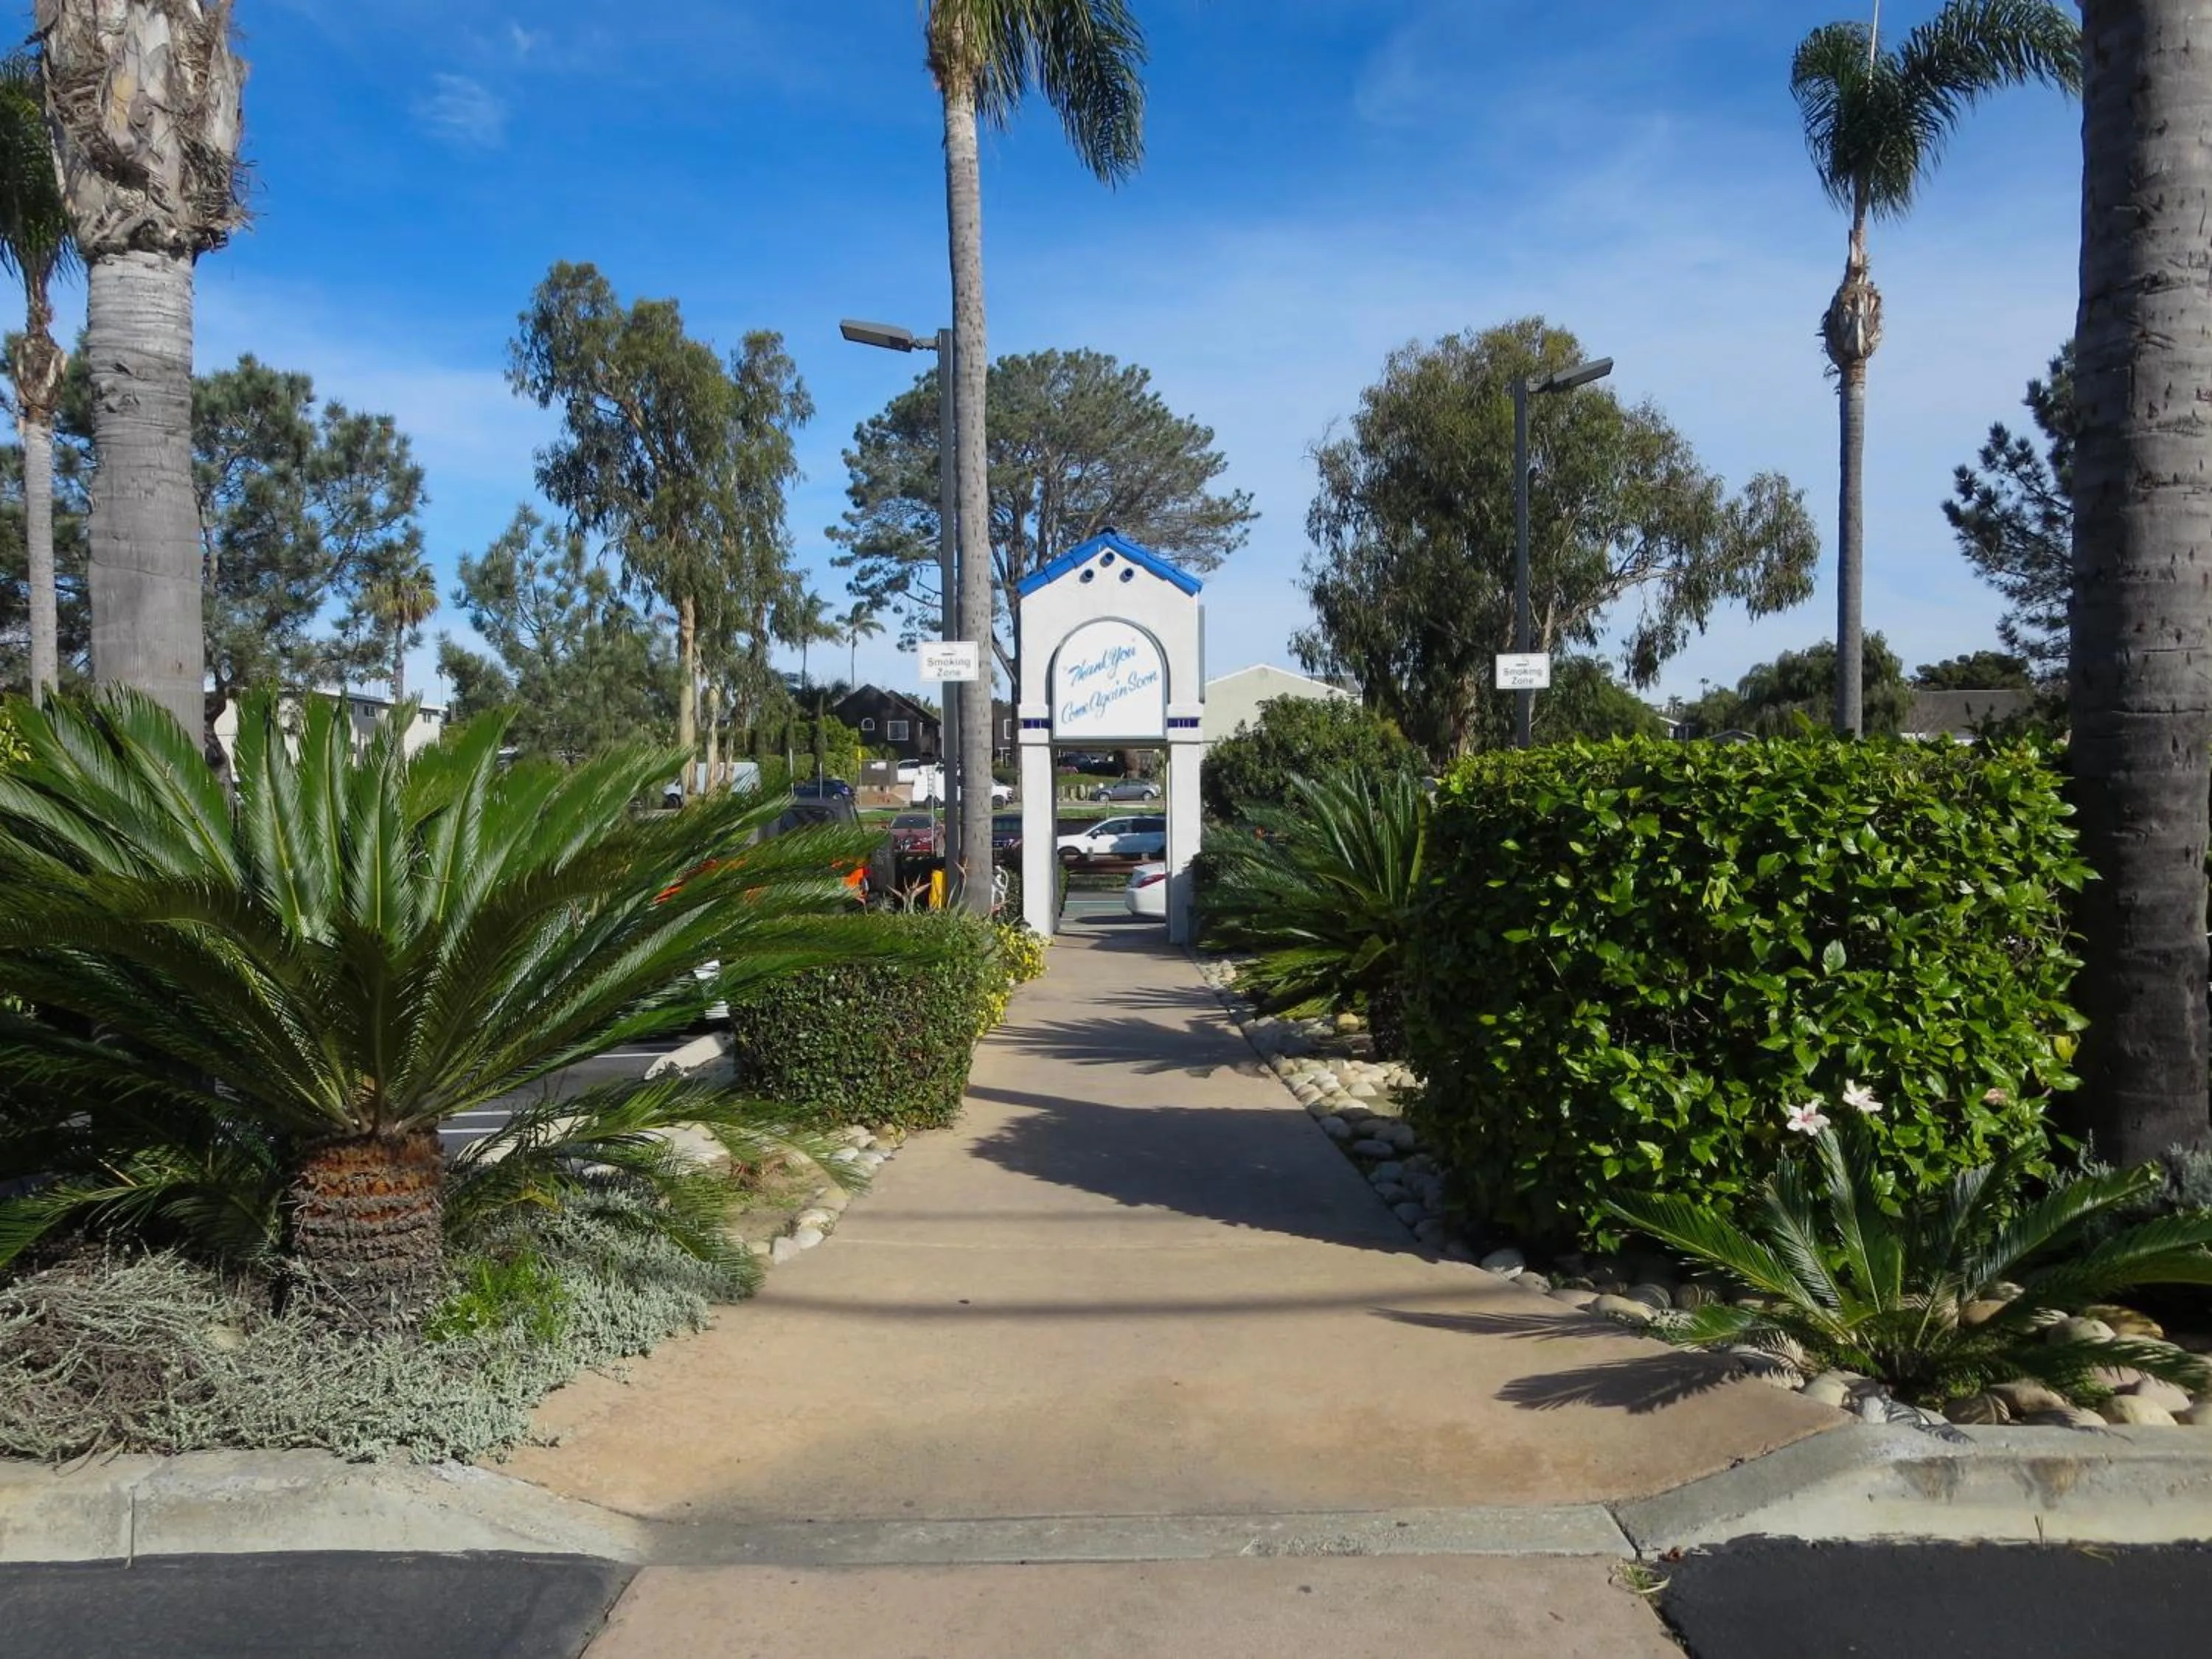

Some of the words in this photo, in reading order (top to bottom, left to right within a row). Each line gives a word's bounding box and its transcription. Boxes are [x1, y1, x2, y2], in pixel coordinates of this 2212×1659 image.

[927, 657, 971, 668] Smoking
[1107, 645, 1135, 679] You
[1512, 677, 1534, 685] Zone
[1061, 701, 1088, 724] Come
[1089, 680, 1127, 720] Again
[1127, 669, 1158, 692] Soon
